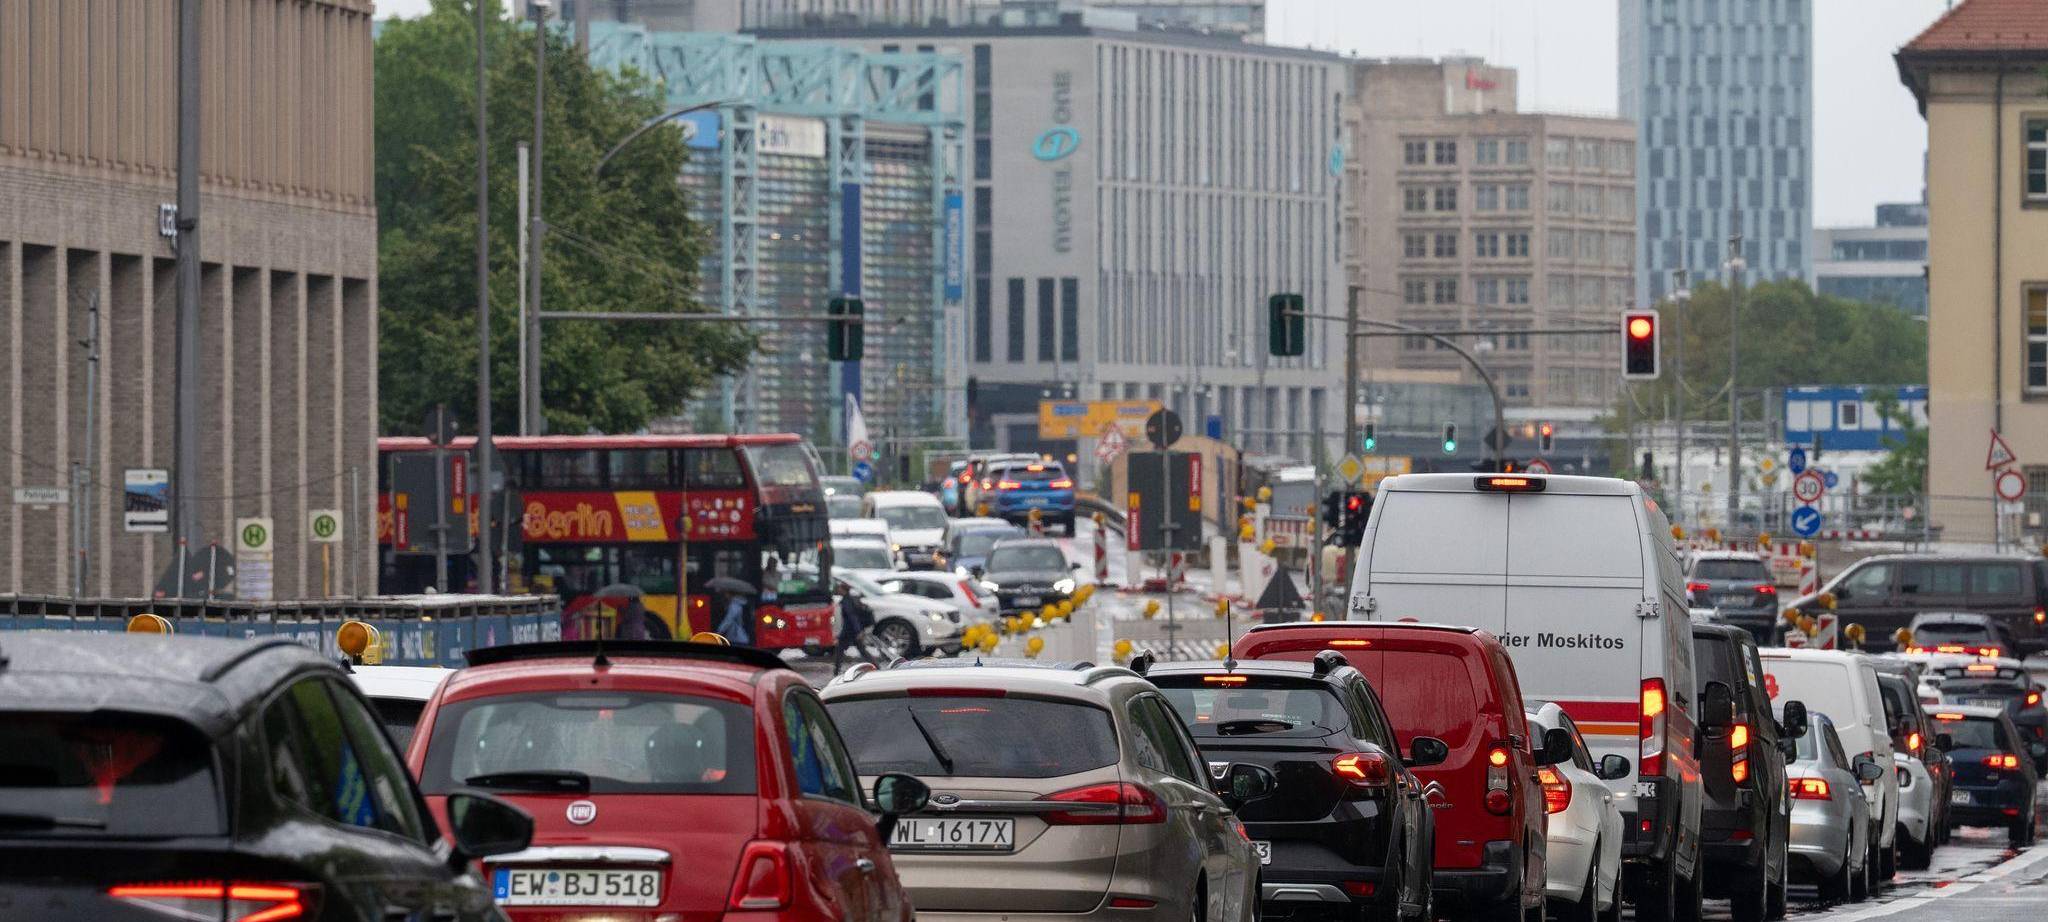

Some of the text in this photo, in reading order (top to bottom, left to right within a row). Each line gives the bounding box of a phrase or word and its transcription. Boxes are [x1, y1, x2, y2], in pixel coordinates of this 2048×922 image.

[1053, 71, 1072, 124] ONE
[1799, 481, 1818, 495] 30
[526, 501, 613, 539] Berlin
[1492, 632, 1624, 649] rier Moskitos
[573, 806, 591, 818] FIAT
[897, 820, 1007, 843] WL 1617X
[511, 873, 654, 896] EW BJ 518
